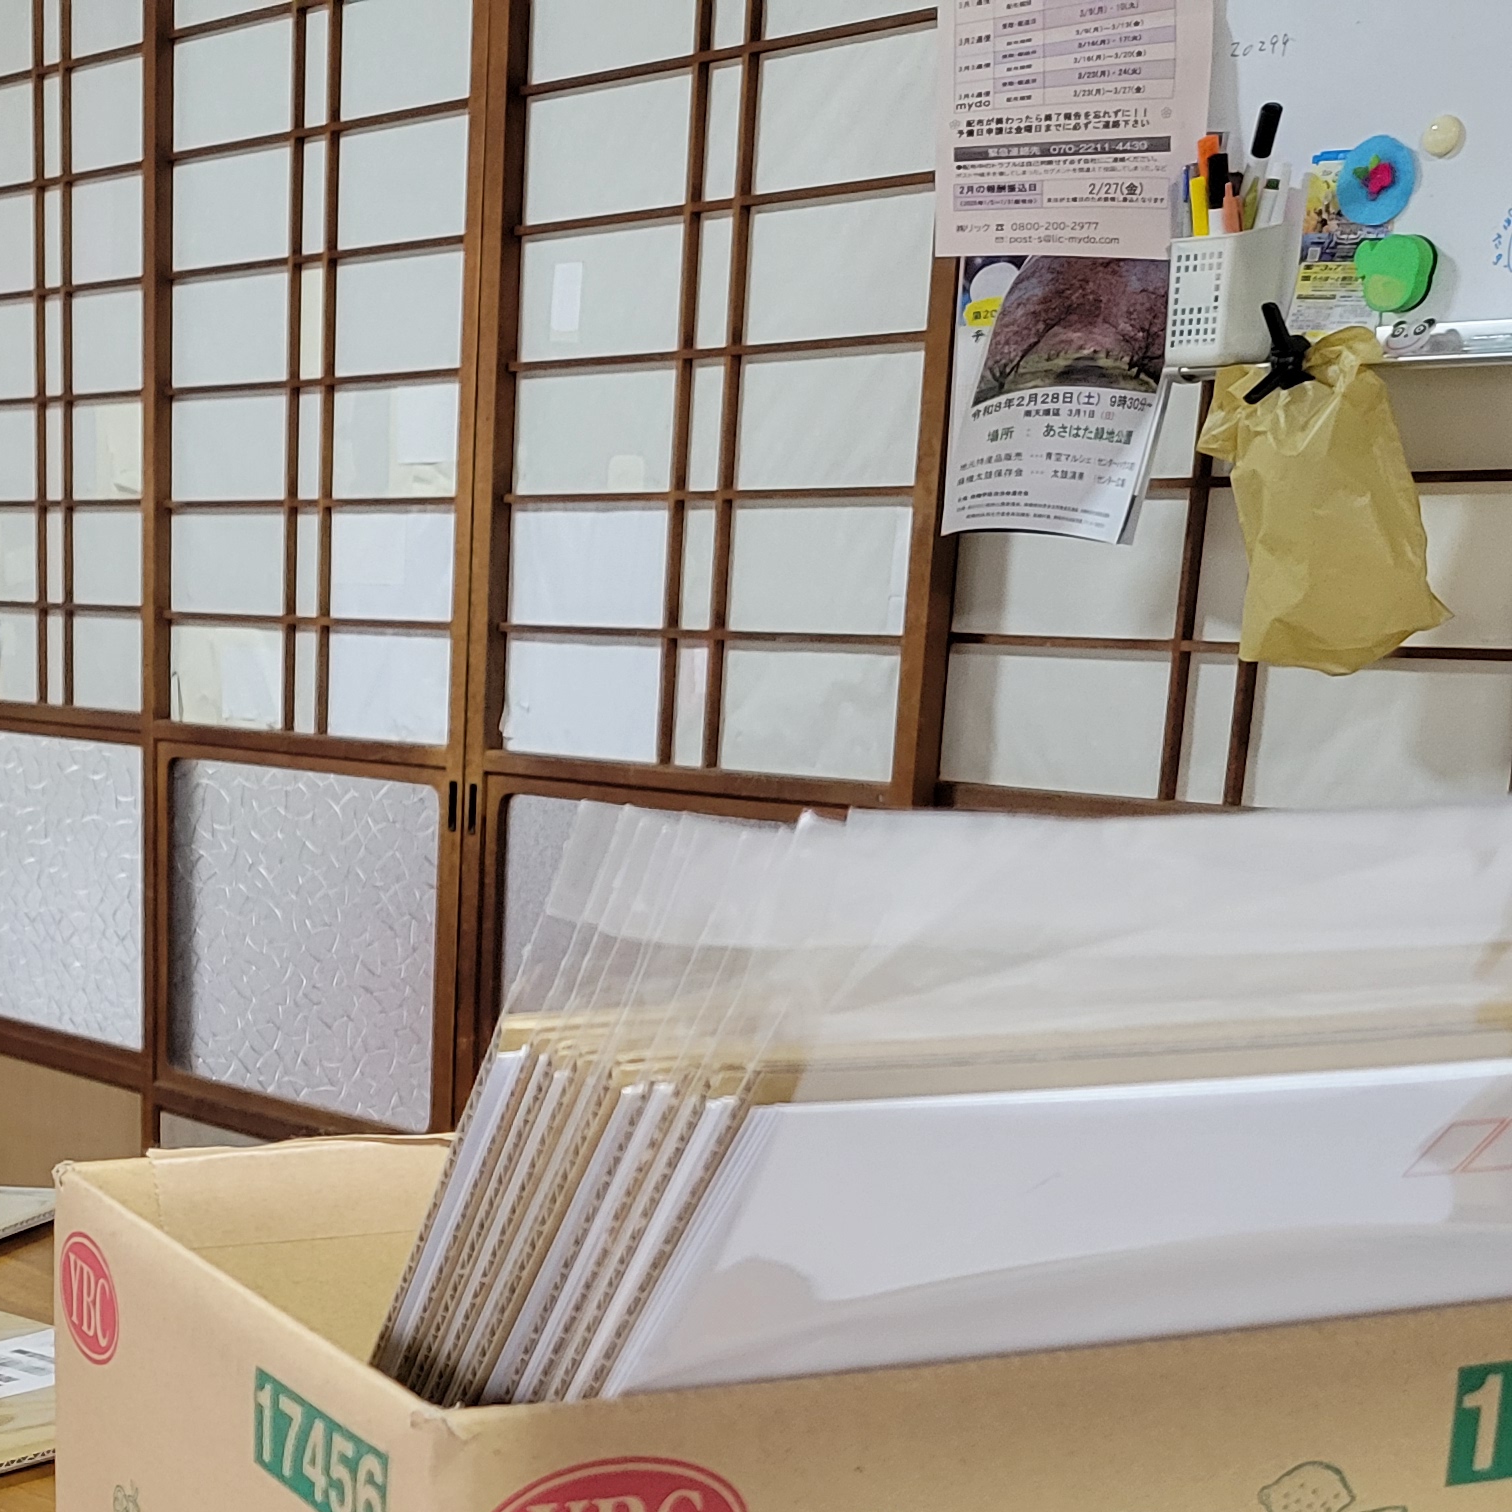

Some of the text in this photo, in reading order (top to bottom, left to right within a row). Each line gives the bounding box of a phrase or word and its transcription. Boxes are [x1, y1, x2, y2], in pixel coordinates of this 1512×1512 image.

[956, 100, 991, 111] mydo
[1088, 182, 1144, 196] 2/27(金)
[1011, 222, 1099, 231] 0800-200-2977
[68, 1251, 111, 1348] YBC
